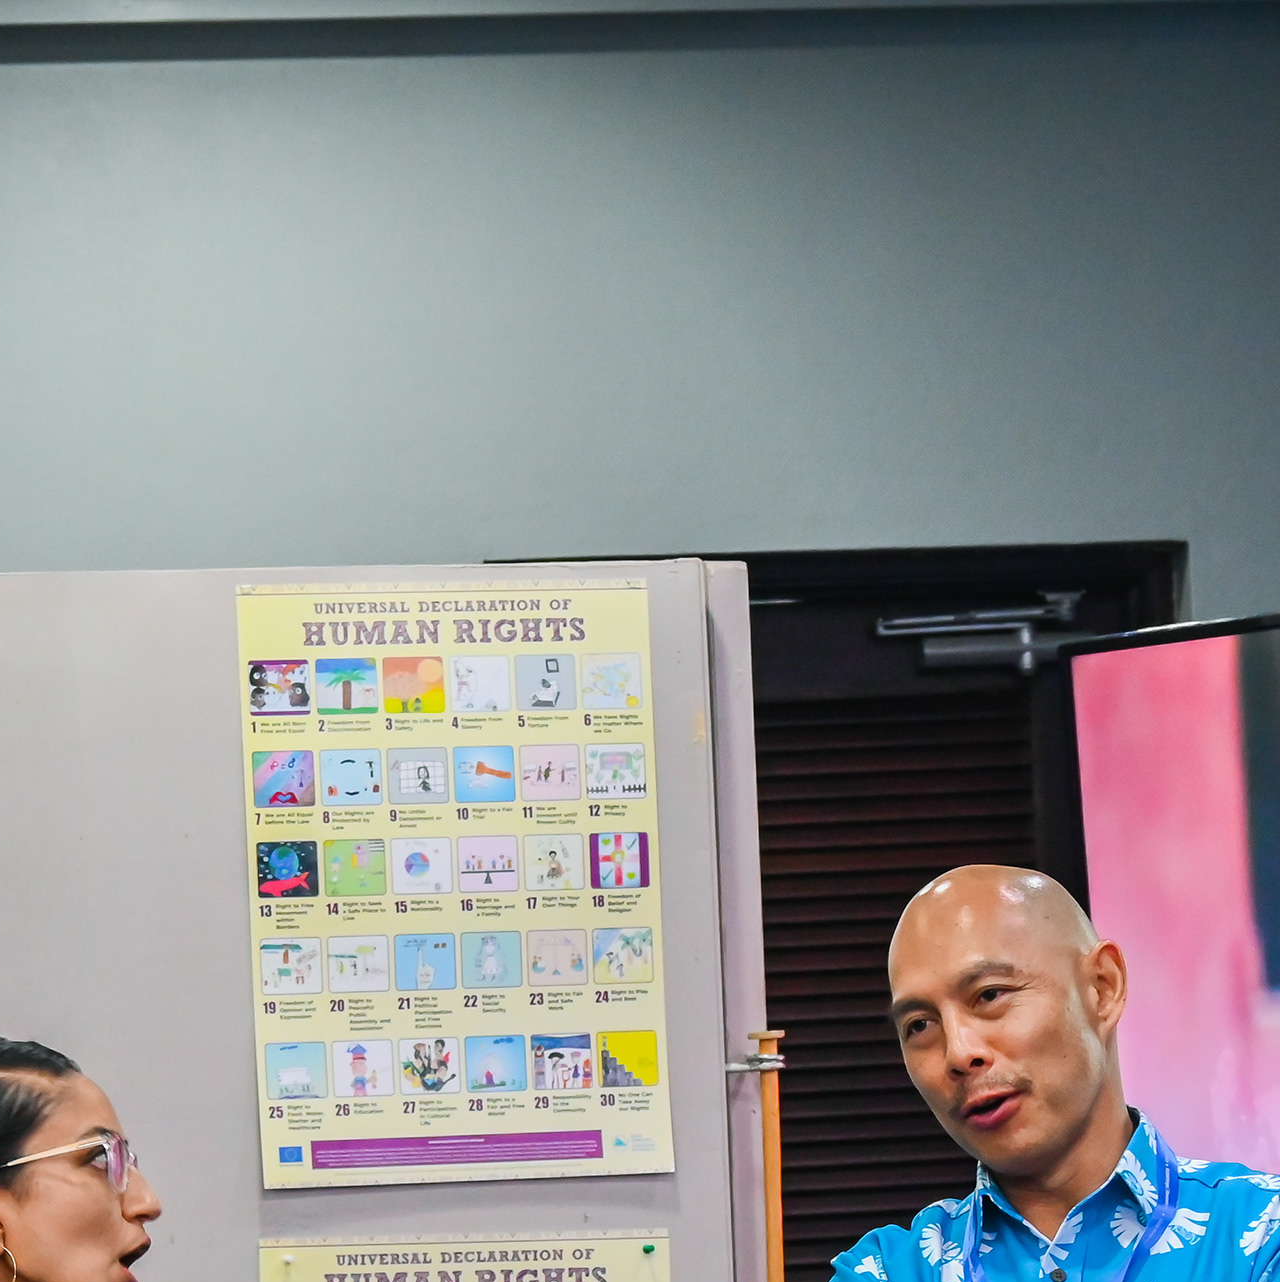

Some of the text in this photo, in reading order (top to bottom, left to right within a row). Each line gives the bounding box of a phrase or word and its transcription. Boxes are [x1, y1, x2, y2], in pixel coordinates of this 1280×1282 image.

[314, 599, 571, 614] UNIVERSAL DECLARATION OF
[302, 618, 585, 646] HUMAN RIGHTS
[318, 720, 325, 731] 2
[386, 718, 392, 730] 3
[452, 717, 458, 728] 4
[518, 715, 525, 727] 5
[584, 714, 591, 726] 6
[251, 722, 256, 733] 1
[390, 810, 397, 821] 9
[456, 808, 468, 820] 10
[523, 807, 532, 818] 11
[589, 805, 600, 816] 12
[255, 813, 260, 825] 7
[323, 811, 330, 823] 8
[395, 901, 407, 913] 15
[460, 899, 473, 911] 16
[526, 897, 537, 909] 17
[592, 895, 604, 907] 18
[259, 905, 272, 917] 13
[326, 903, 339, 915] 14
[464, 995, 477, 1007] 22
[530, 993, 544, 1005] 23
[595, 991, 609, 1003] 24
[263, 1002, 276, 1014] 19
[330, 999, 344, 1012] 20
[398, 998, 410, 1009] 21
[469, 1099, 483, 1111] 28
[535, 1096, 549, 1109] 29
[600, 1094, 615, 1106] 30
[269, 1106, 283, 1118] 25
[335, 1104, 350, 1116] 26
[403, 1101, 415, 1113] 27
[336, 1249, 594, 1266] UNIVERSAL DECLARATION OF
